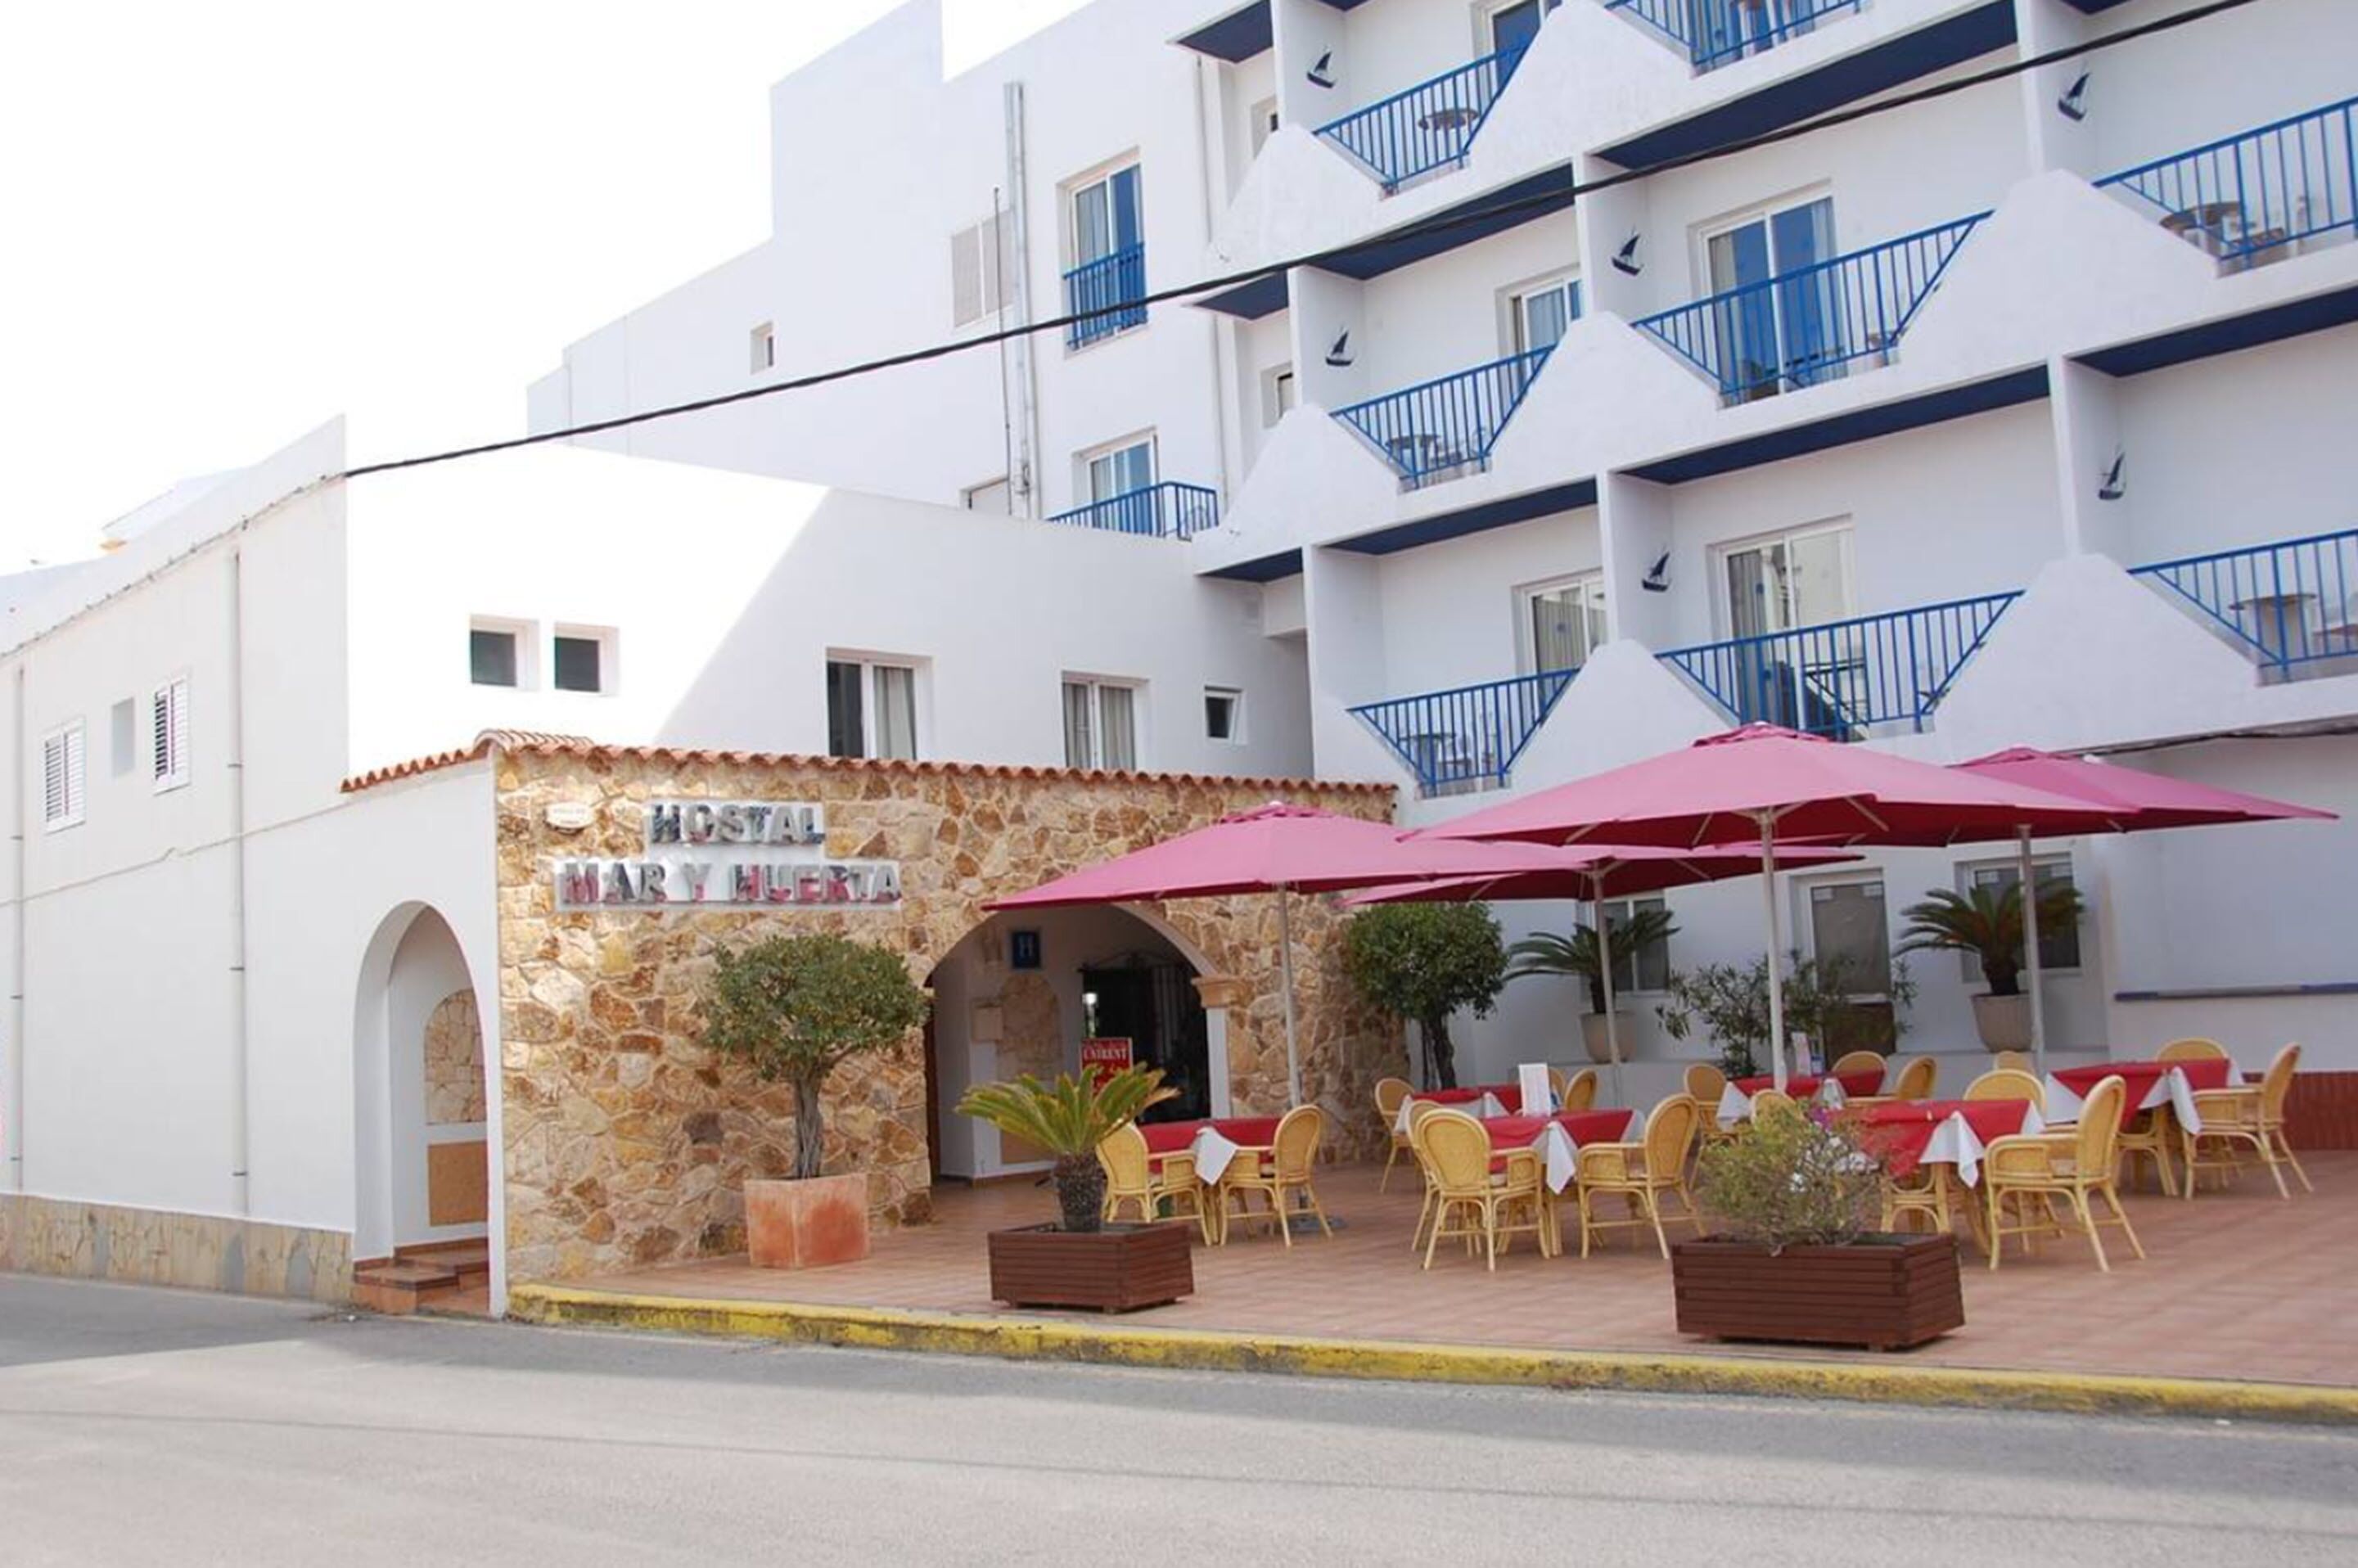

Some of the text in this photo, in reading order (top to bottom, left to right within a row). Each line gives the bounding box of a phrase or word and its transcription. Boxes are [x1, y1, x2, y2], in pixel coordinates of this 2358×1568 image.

[651, 804, 826, 844] HOSTAL
[565, 862, 901, 903] MAR Y HUERTA
[1018, 935, 1033, 957] H
